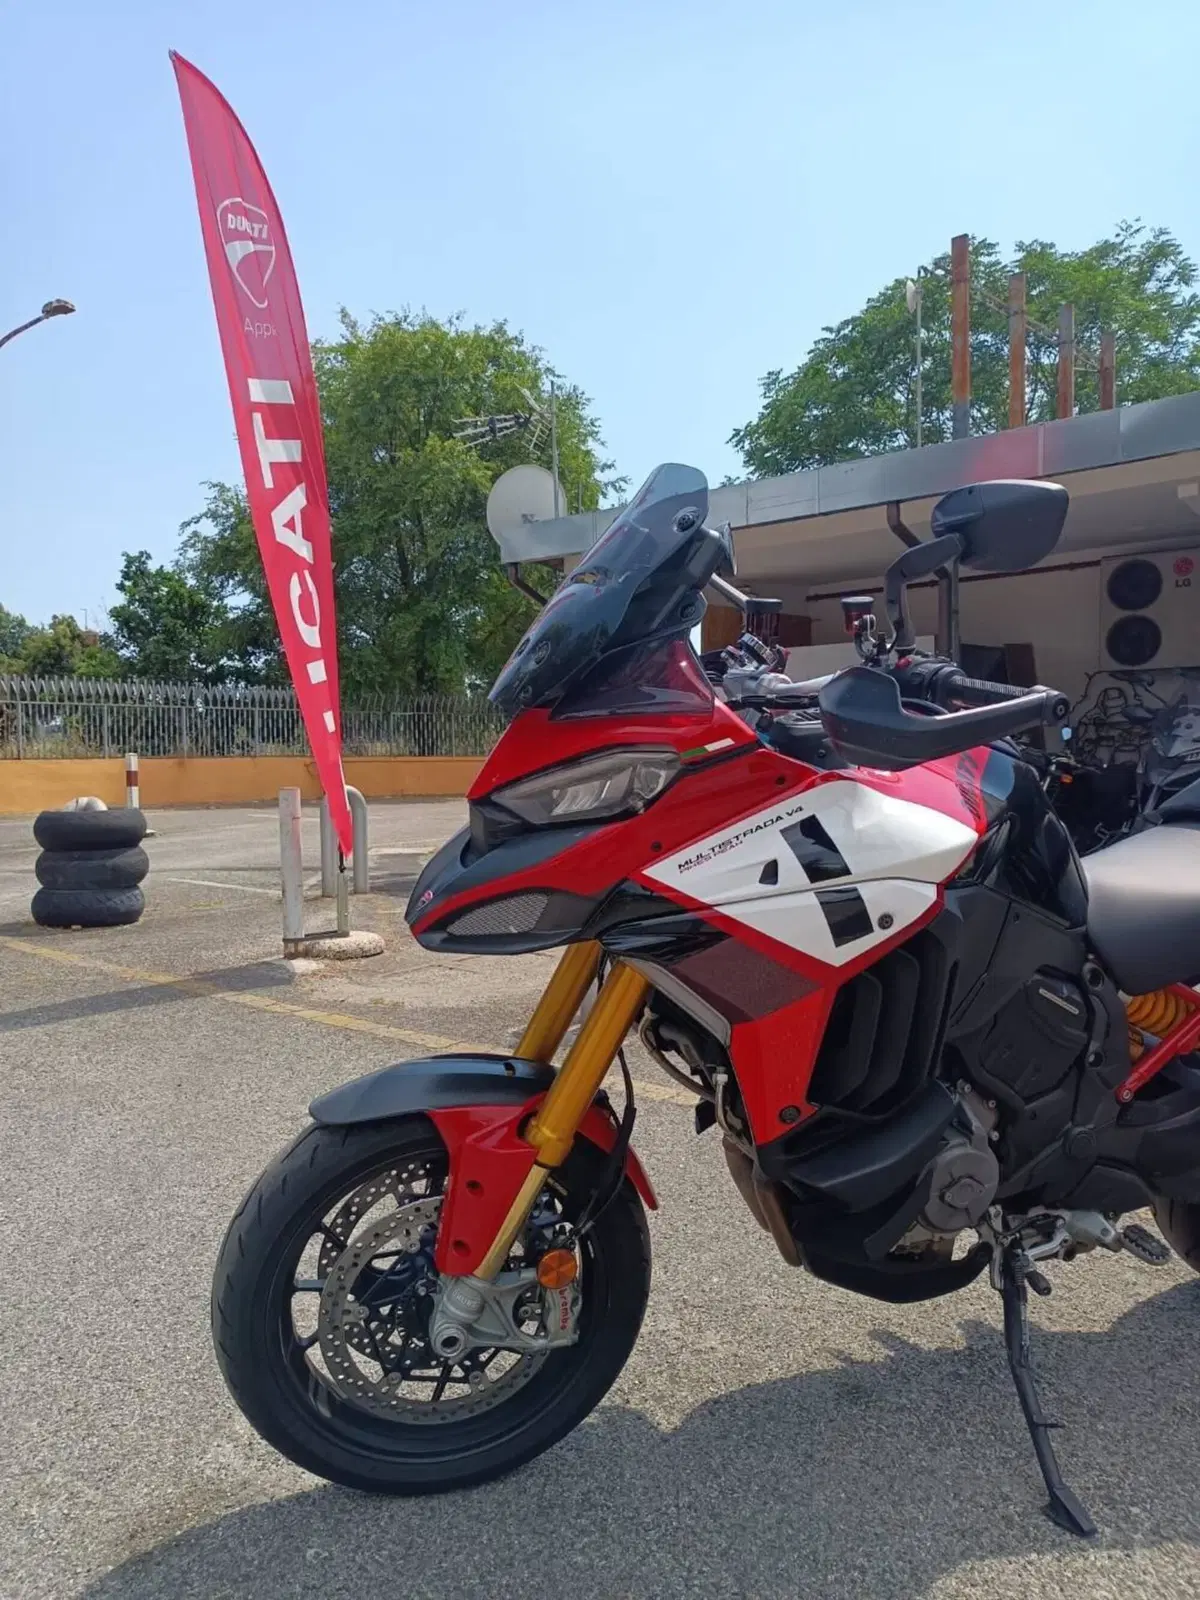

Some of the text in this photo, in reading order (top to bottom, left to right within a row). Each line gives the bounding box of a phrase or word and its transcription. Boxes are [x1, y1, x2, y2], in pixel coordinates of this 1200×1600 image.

[1175, 578, 1191, 588] LG
[678, 805, 804, 870] MULTISTRADA V4
[559, 1287, 569, 1330] brembo
